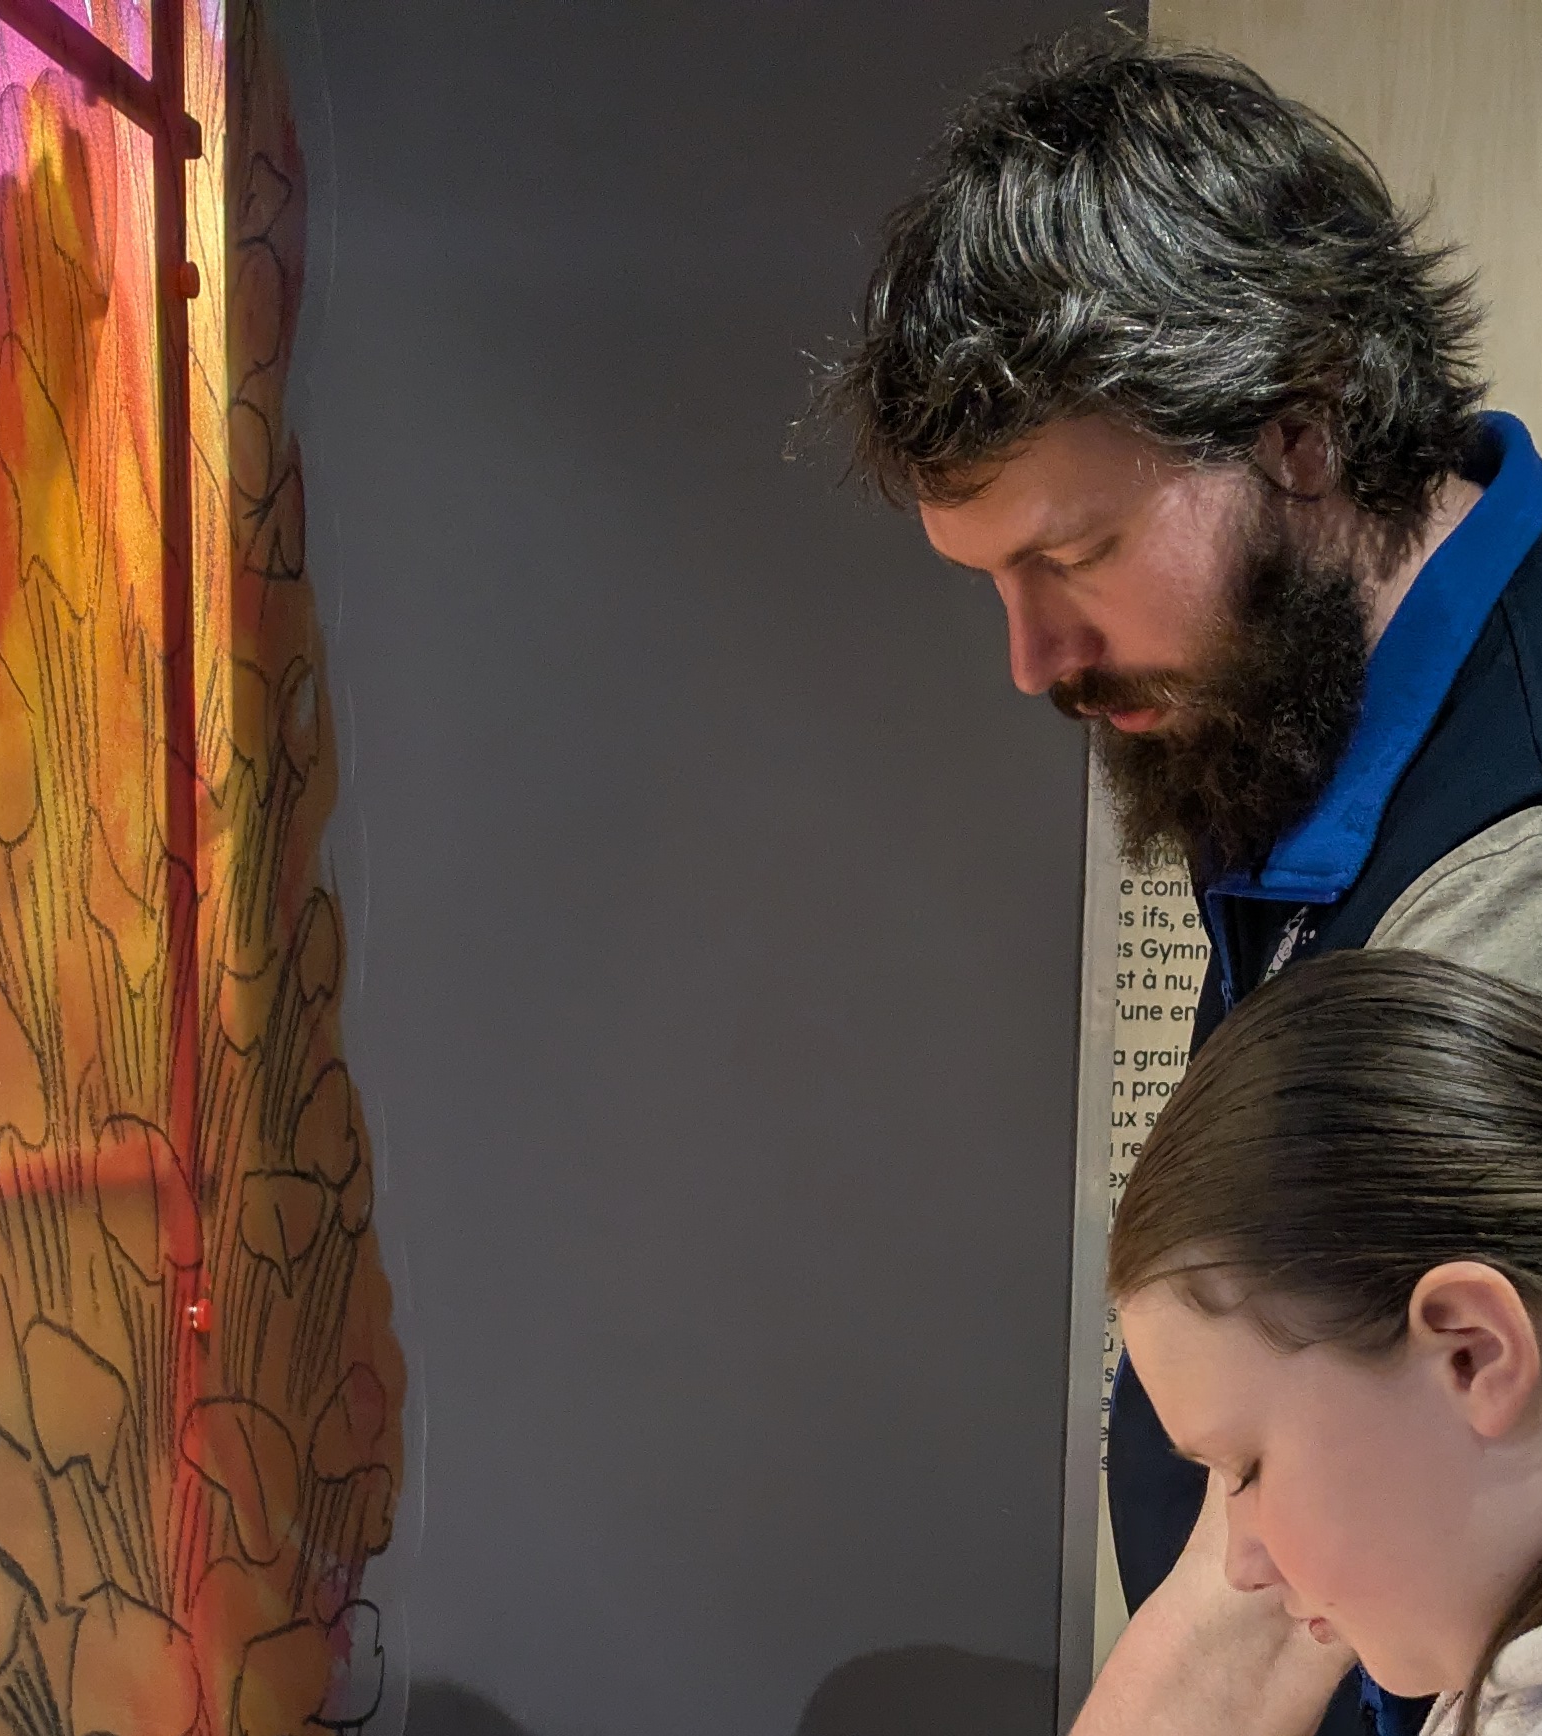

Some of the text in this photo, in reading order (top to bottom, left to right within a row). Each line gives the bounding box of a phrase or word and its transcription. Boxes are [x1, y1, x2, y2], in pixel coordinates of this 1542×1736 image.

[1141, 874, 1192, 897] coni
[1142, 905, 1175, 932] ifs,
[1140, 938, 1208, 965] Gymn
[1116, 967, 1199, 995] st à nu,
[1115, 999, 1197, 1021] ’une en
[1133, 1045, 1189, 1072] grain
[1112, 1111, 1137, 1128] ux
